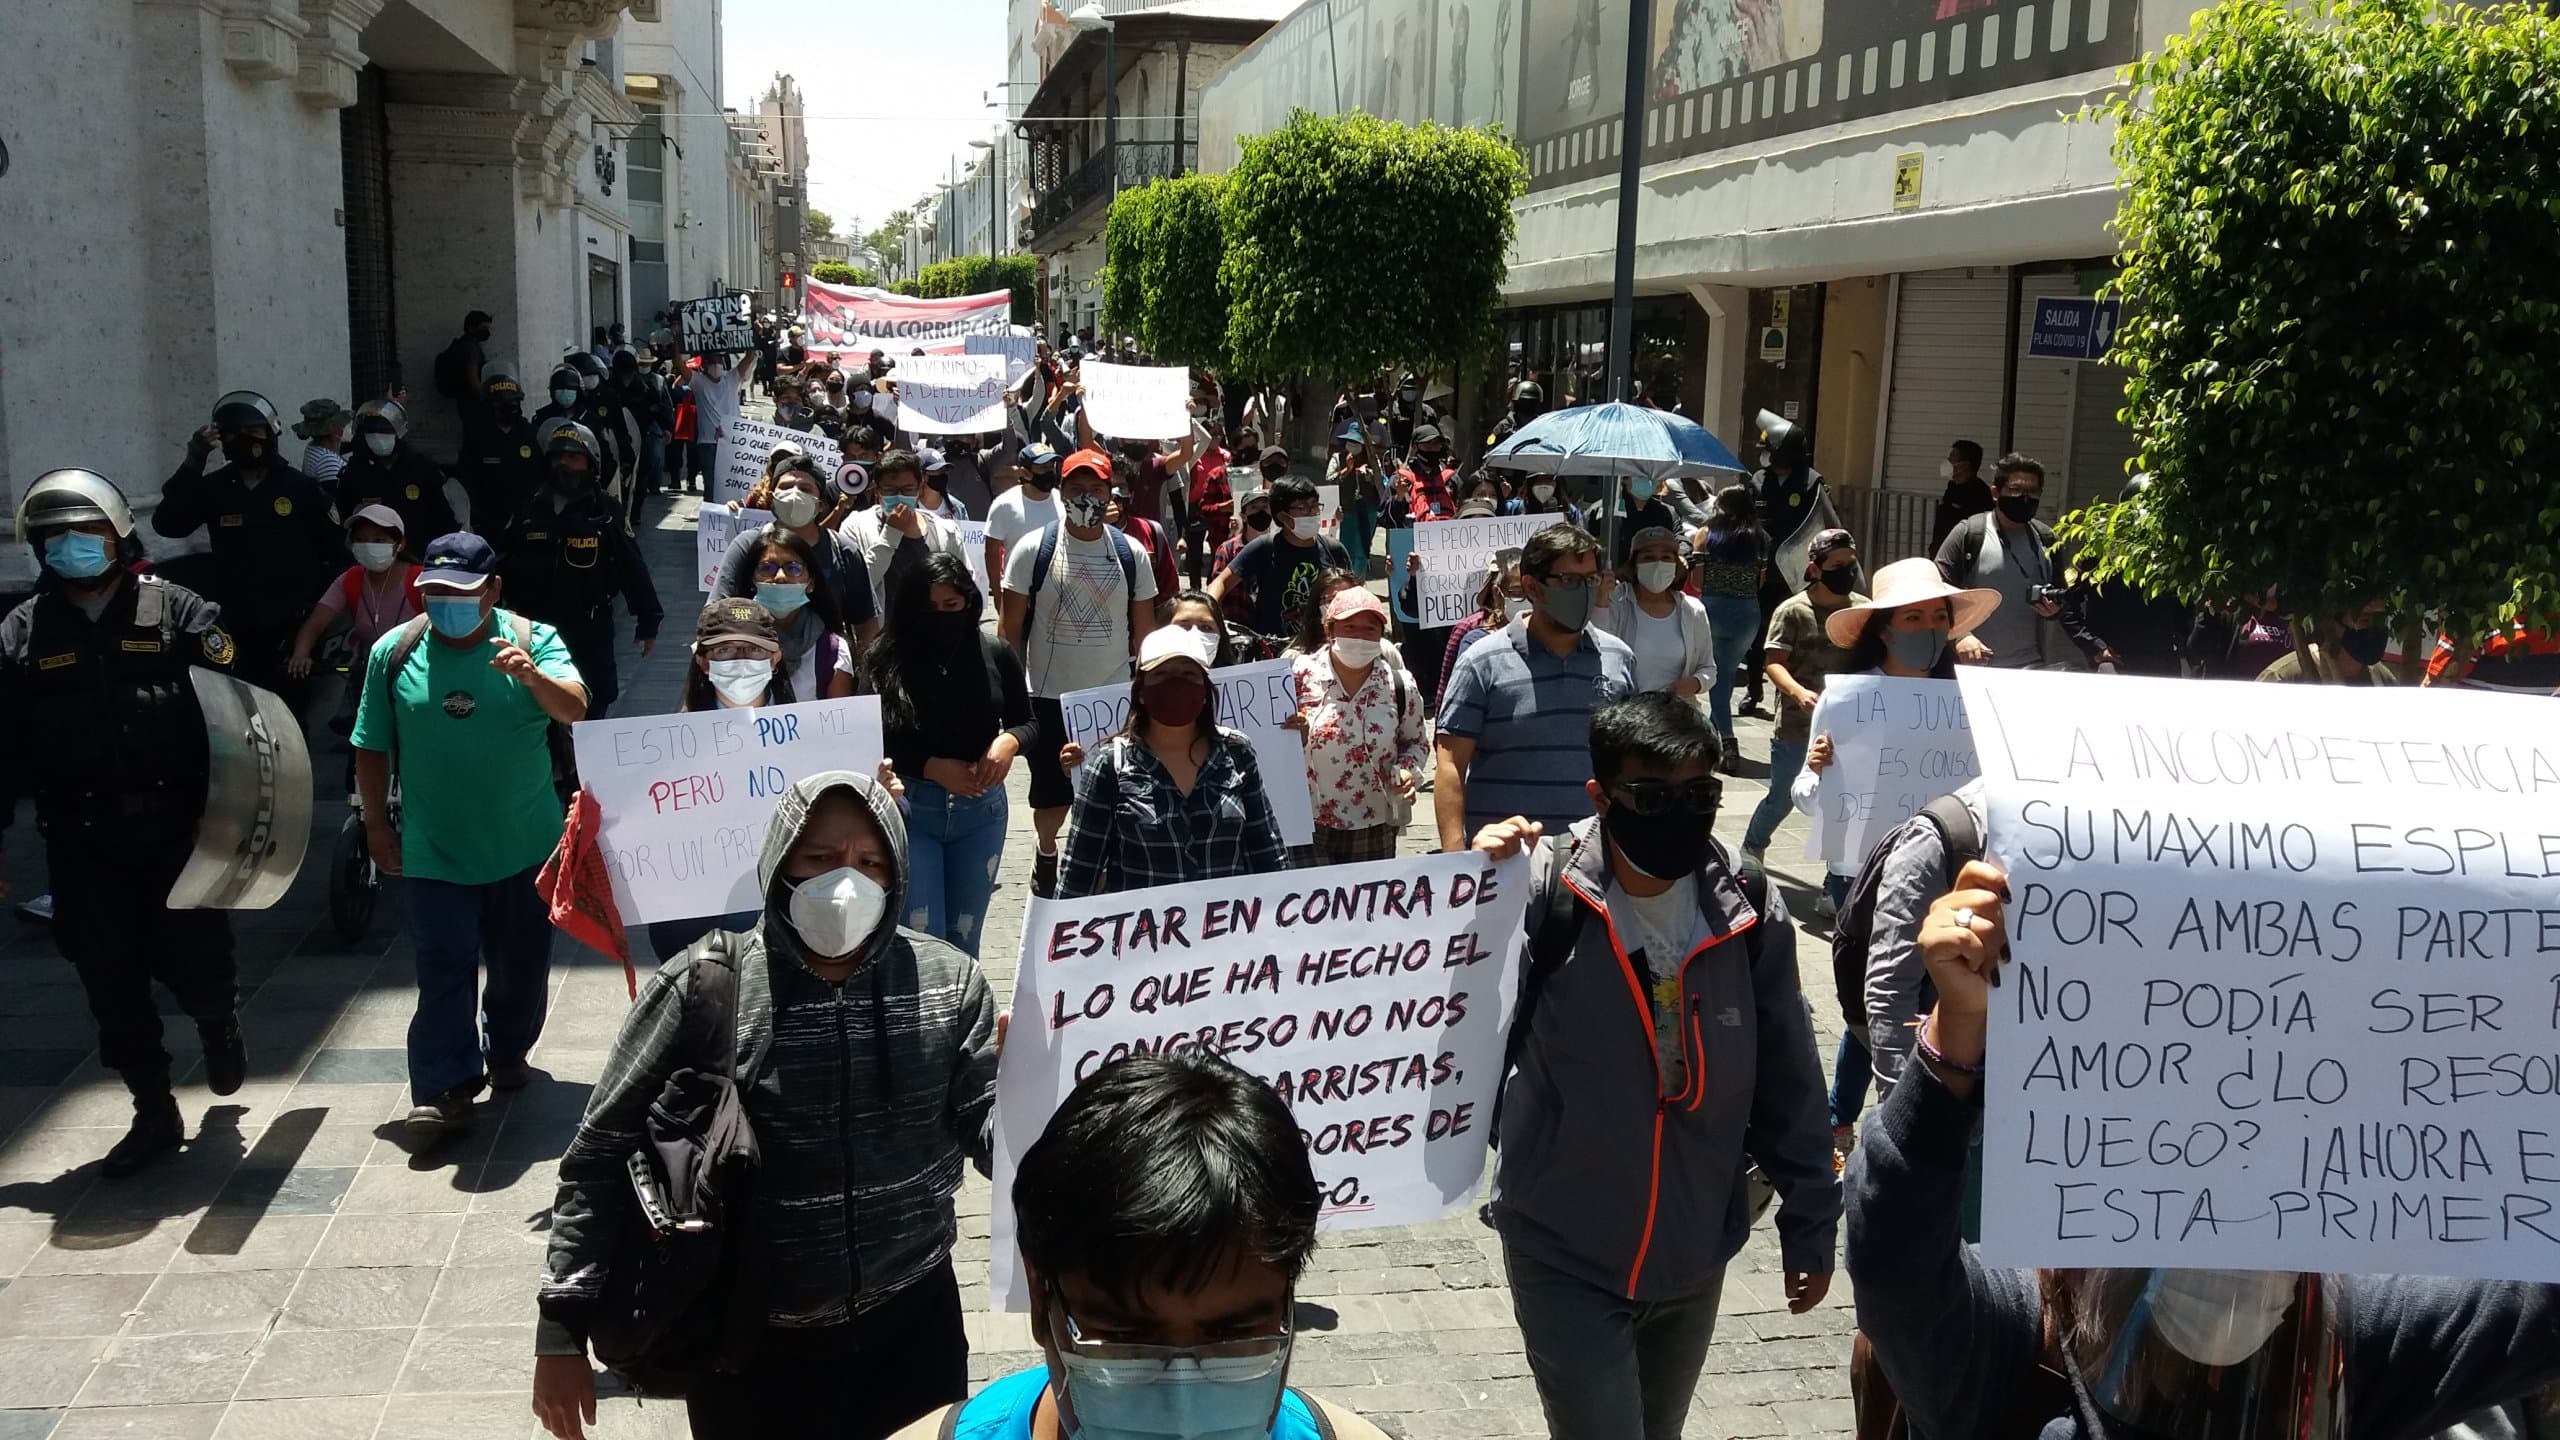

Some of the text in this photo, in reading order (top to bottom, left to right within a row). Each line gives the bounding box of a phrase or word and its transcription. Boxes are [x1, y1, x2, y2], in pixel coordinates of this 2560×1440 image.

[681, 309, 753, 334] NO ES
[859, 319, 871, 336] A
[873, 320, 895, 339] LA
[2045, 309, 2080, 327] SALIDA
[684, 334, 700, 351] MI
[2033, 332, 2086, 348] PLAN COVID 19
[905, 384, 914, 400] A
[731, 436, 746, 446] LO
[749, 440, 770, 451] QUE
[827, 459, 839, 468] EL
[732, 421, 766, 437] ESTAR
[767, 429, 783, 440] EN
[785, 432, 826, 453] CONTRA
[725, 479, 750, 491] SINO
[730, 466, 758, 478] HACE
[709, 514, 723, 532] NI
[1418, 529, 1434, 552] EL
[1441, 525, 1481, 551] PEOR
[707, 537, 725, 553] NI
[1447, 553, 1467, 572] UN
[731, 607, 752, 615] TEAM
[735, 612, 750, 620] 911
[1267, 674, 1298, 728] ES
[1855, 689, 1887, 723] LA
[612, 707, 855, 768] ESTO ES POR MI
[1985, 687, 2560, 794] LA INCOMPETENCIA
[1878, 747, 1909, 779] ES
[648, 765, 786, 814] PERÚ NO
[1834, 791, 1879, 824] DE
[667, 834, 706, 882] UN
[713, 822, 770, 868] PRE
[2022, 799, 2095, 871] SU
[2112, 807, 2317, 873] MAXIMO
[1048, 867, 1500, 963] ESTAR EN CONTRA DE
[2016, 882, 2143, 948] POR
[2168, 896, 2363, 963] AMBAS
[1050, 931, 1493, 1032] LO QUE HA HECHO EL
[2019, 961, 2092, 1025] NO
[2143, 972, 2318, 1036] PODÍA
[2368, 991, 2504, 1034] SER
[1306, 1001, 1375, 1043] NO
[1383, 989, 1470, 1033] NOS
[2022, 1035, 2193, 1093] AMOR
[1425, 1101, 1475, 1143] DE
[2024, 1109, 2263, 1170] LUEGO?
[2300, 1113, 2493, 1191] ¡AHORA
[2057, 1182, 2222, 1243] ESTA
